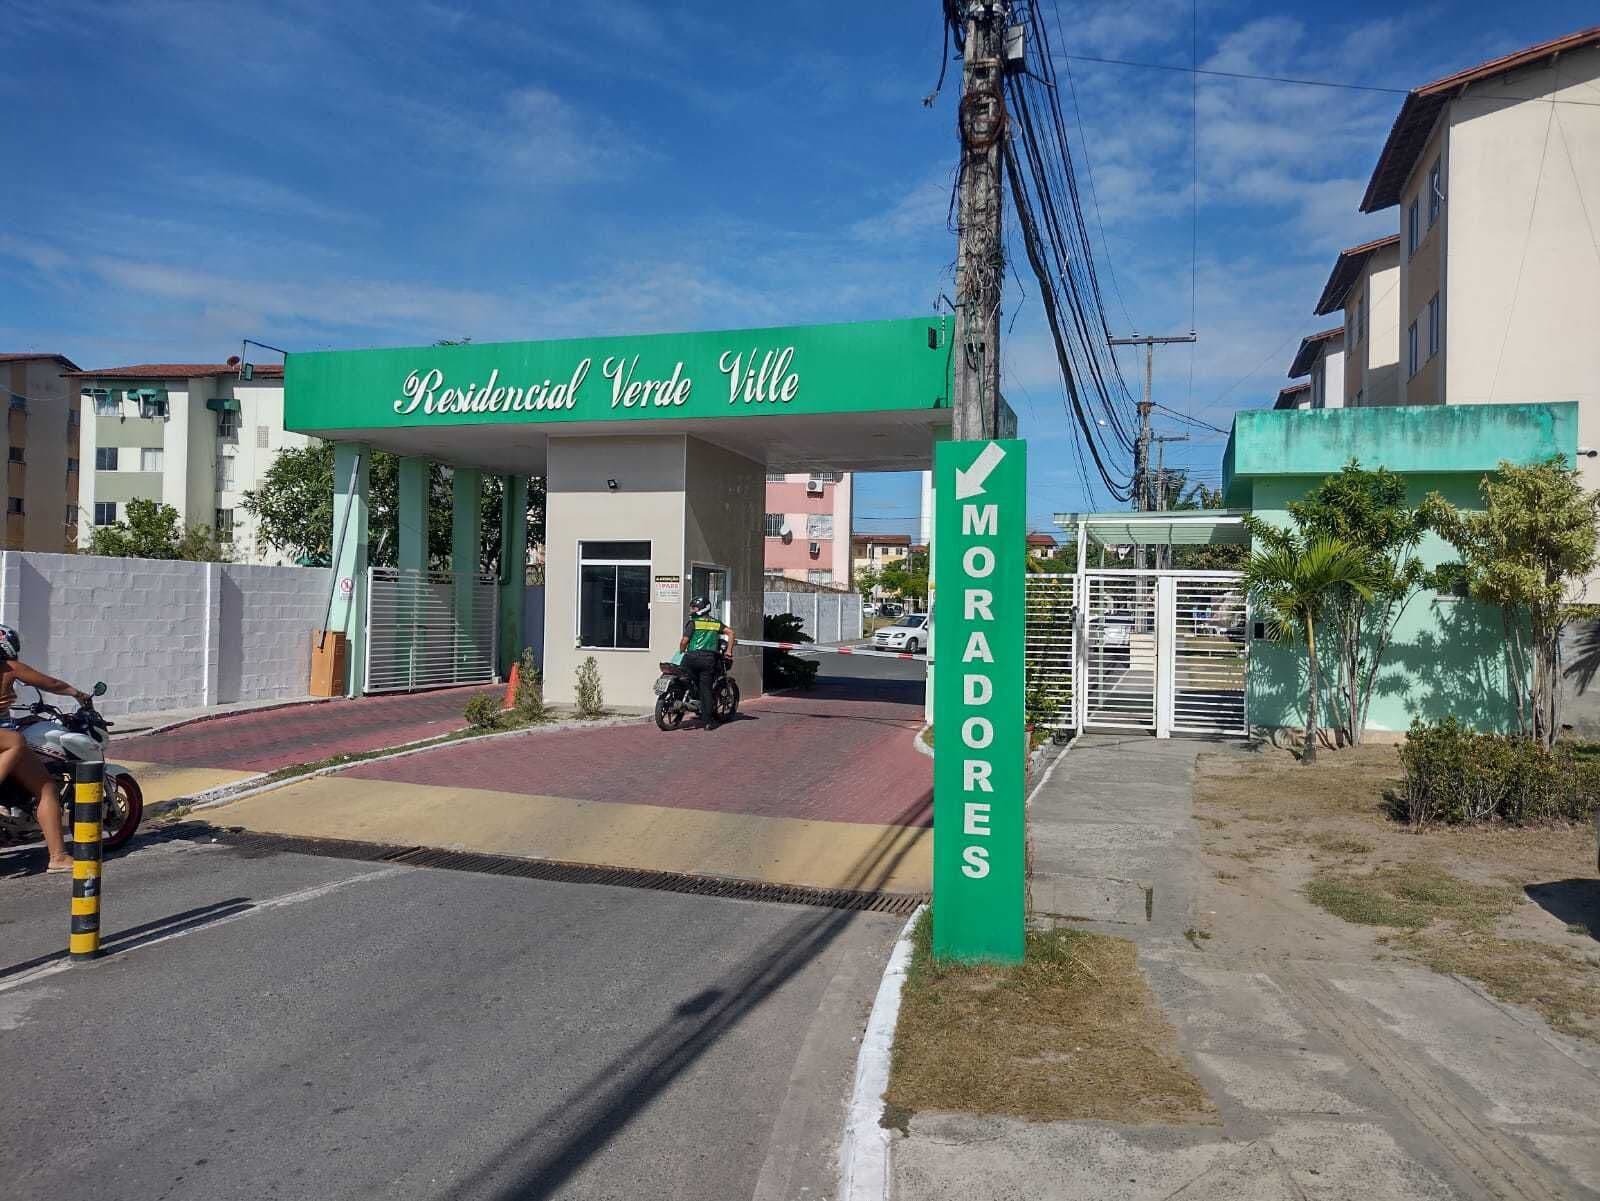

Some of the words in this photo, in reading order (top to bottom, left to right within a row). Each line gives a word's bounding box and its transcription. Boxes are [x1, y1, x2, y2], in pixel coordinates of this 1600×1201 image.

[394, 359, 590, 414] Residencial
[603, 355, 691, 407] Verde
[720, 346, 799, 403] Ville
[962, 504, 998, 878] MORADORES
